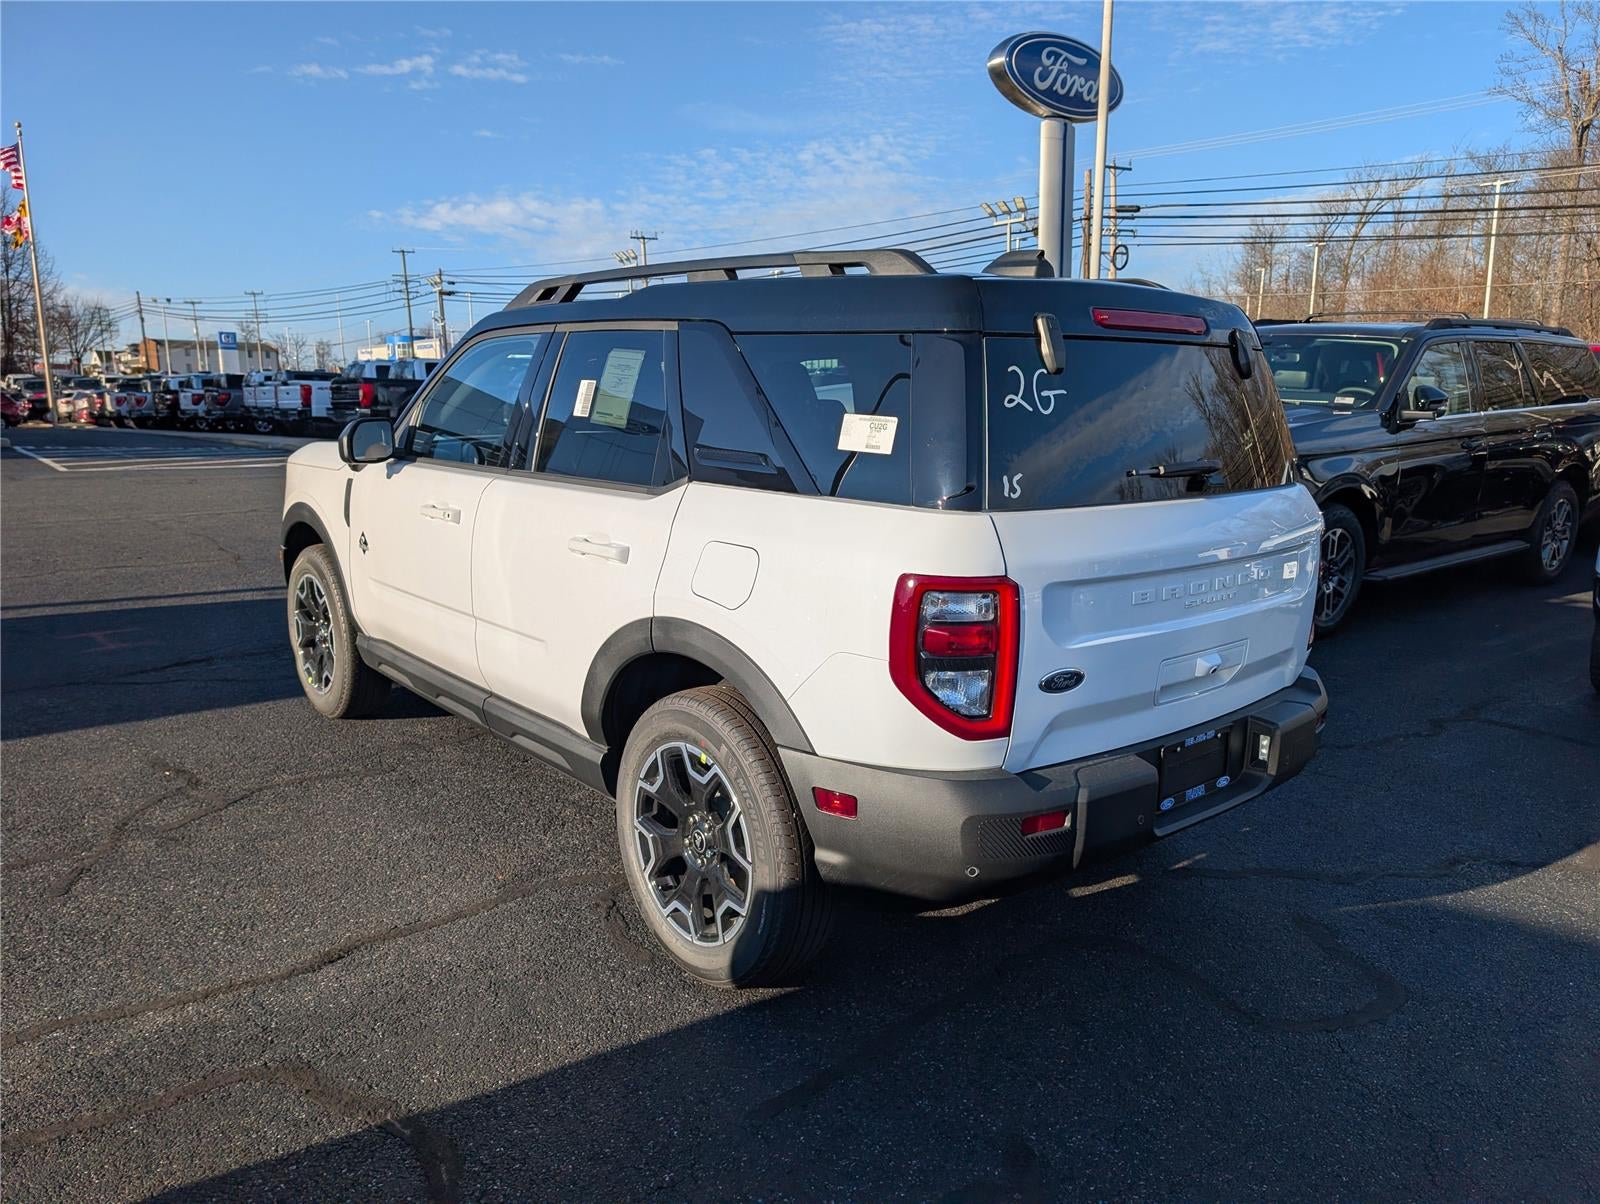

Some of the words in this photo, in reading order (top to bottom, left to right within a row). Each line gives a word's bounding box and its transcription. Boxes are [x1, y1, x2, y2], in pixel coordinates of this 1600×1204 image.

[1003, 364, 1067, 415] 2G
[1132, 568, 1270, 606] BRONCO
[1051, 672, 1078, 689] Ford
